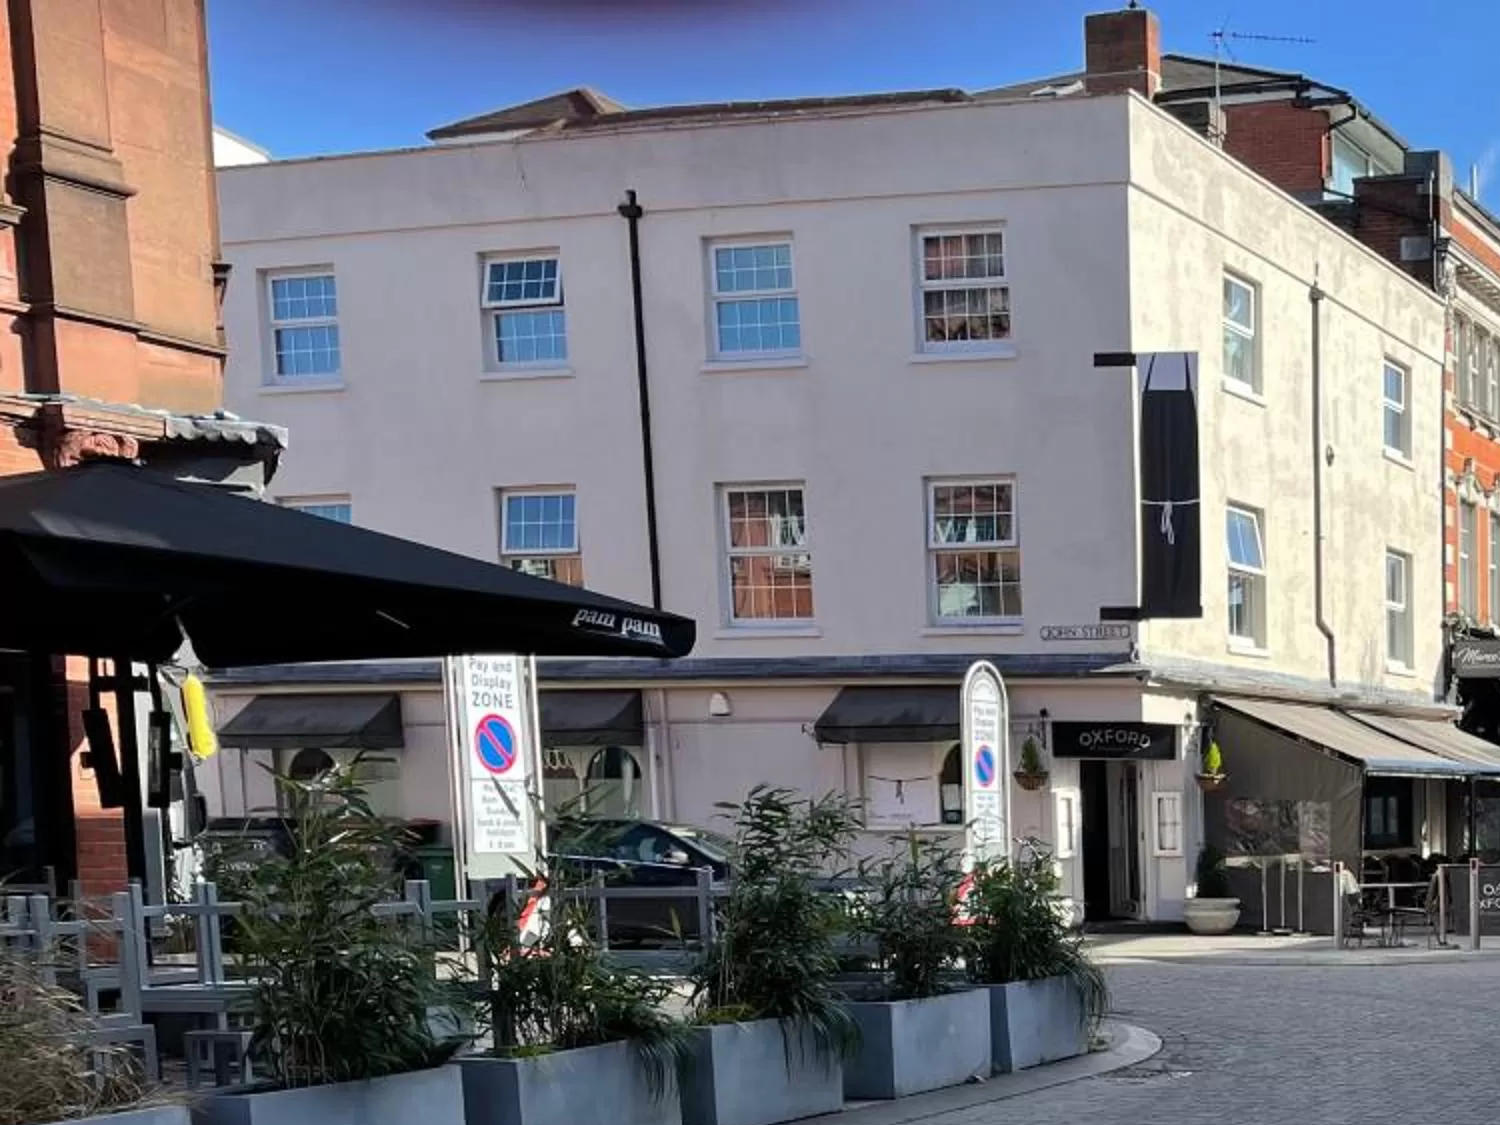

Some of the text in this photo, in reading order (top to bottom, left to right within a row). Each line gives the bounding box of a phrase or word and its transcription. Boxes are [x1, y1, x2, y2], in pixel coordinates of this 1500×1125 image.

[571, 608, 662, 638] pam pam
[1045, 626, 1129, 639] JOHN STREET
[469, 657, 513, 673] Pay and
[471, 674, 513, 692] Display
[472, 691, 513, 709] ZONE
[1079, 729, 1151, 749] OXFORD
